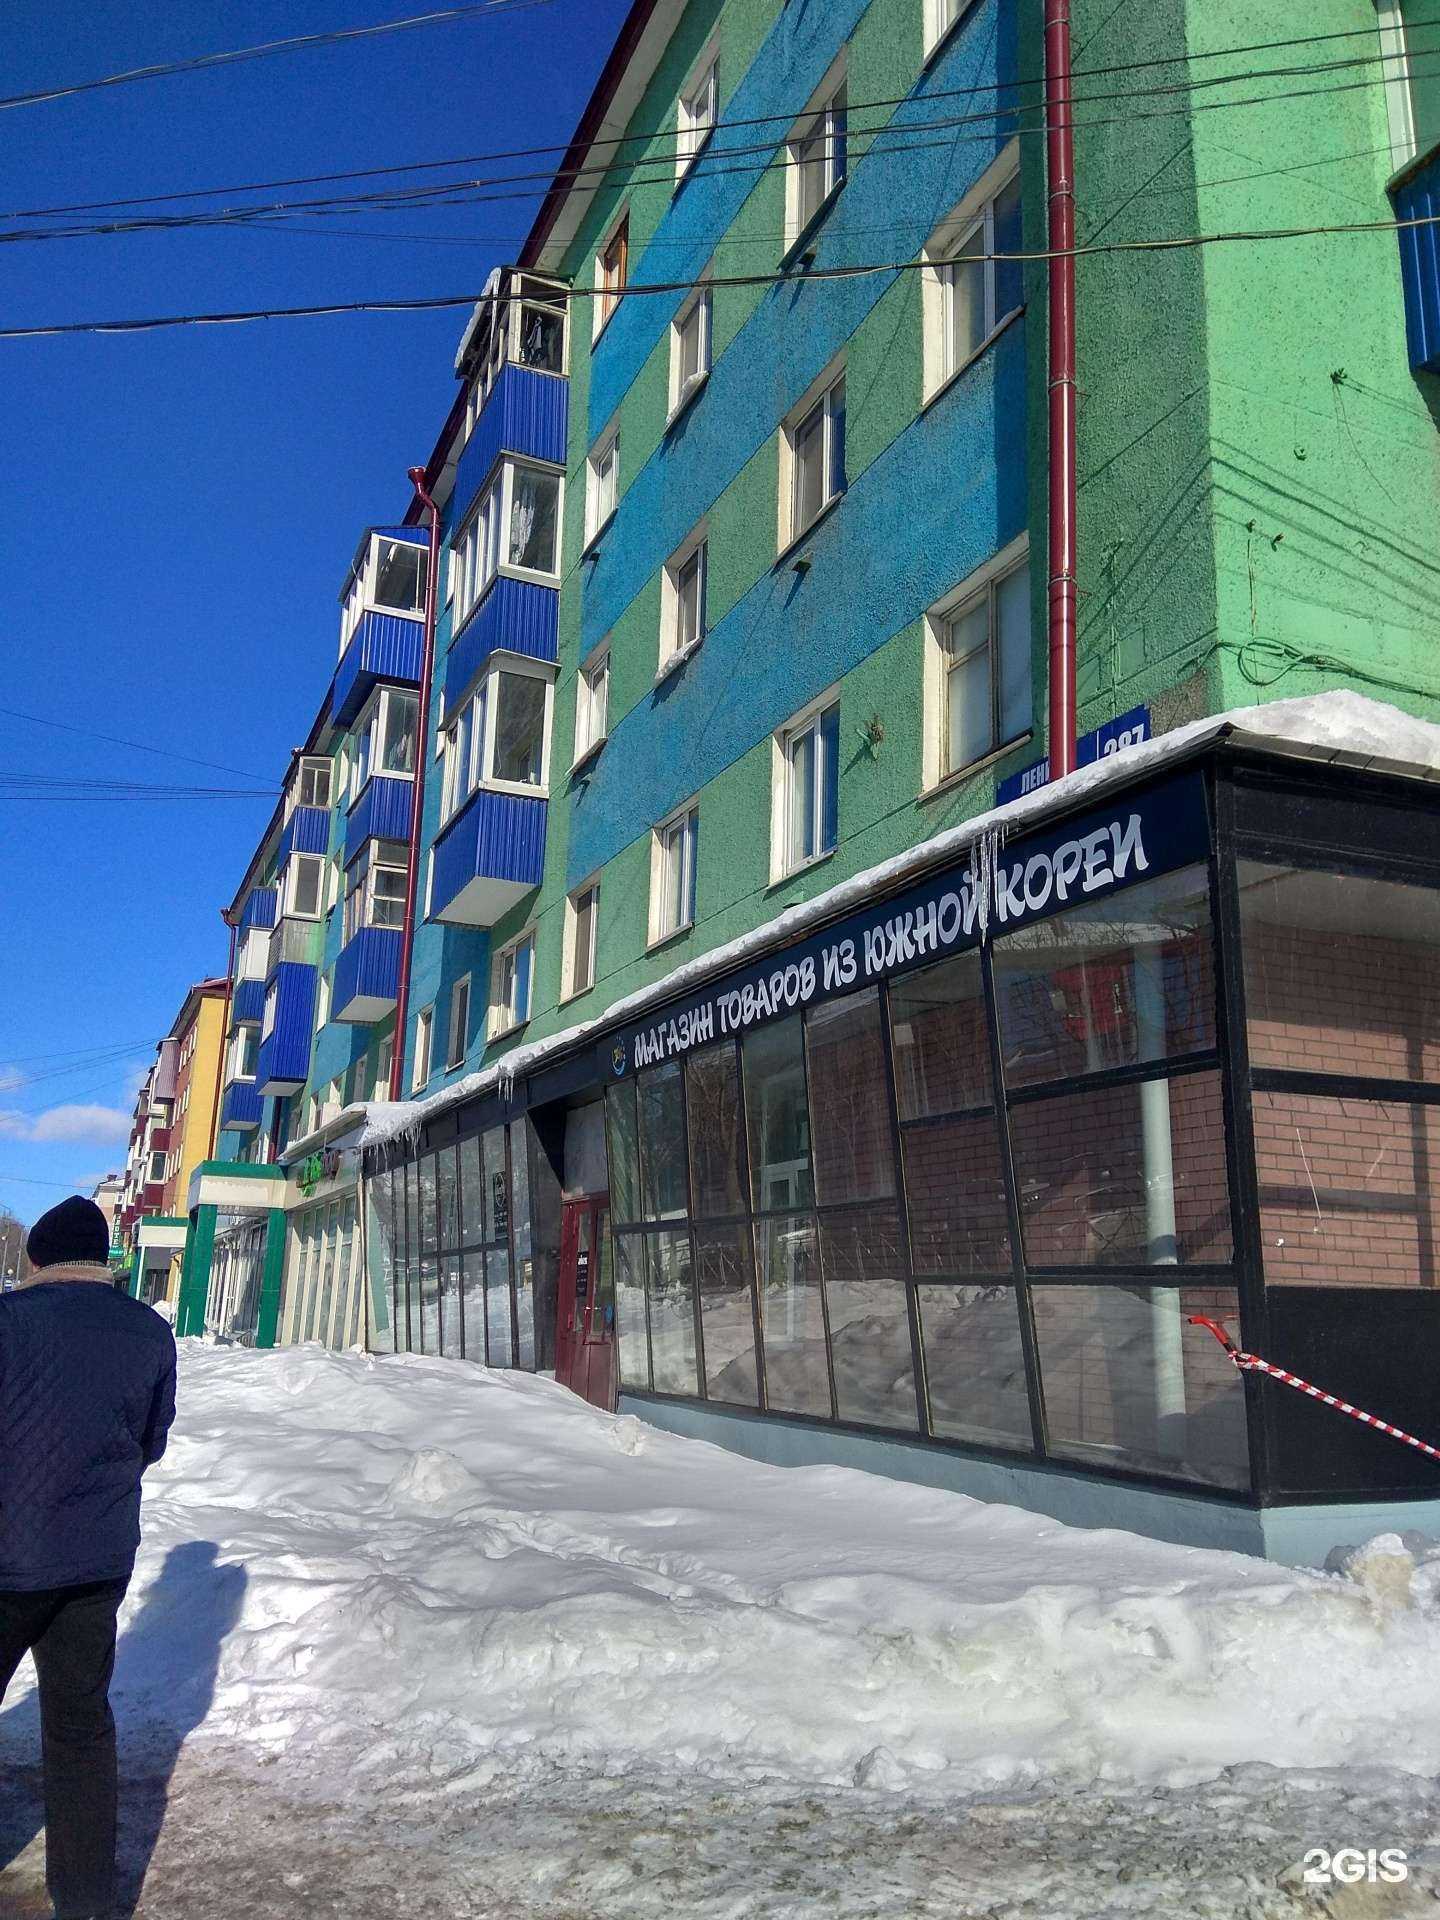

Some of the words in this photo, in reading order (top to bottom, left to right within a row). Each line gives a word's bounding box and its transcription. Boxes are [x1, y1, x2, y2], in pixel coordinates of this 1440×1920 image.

[634, 1002, 714, 1069] МАГАЗИН
[717, 955, 815, 1033] ТОВАРОВ
[822, 938, 857, 989] ИЗ
[863, 869, 989, 975] ЮЖНОЙ
[997, 813, 1150, 922] КОРЕИ
